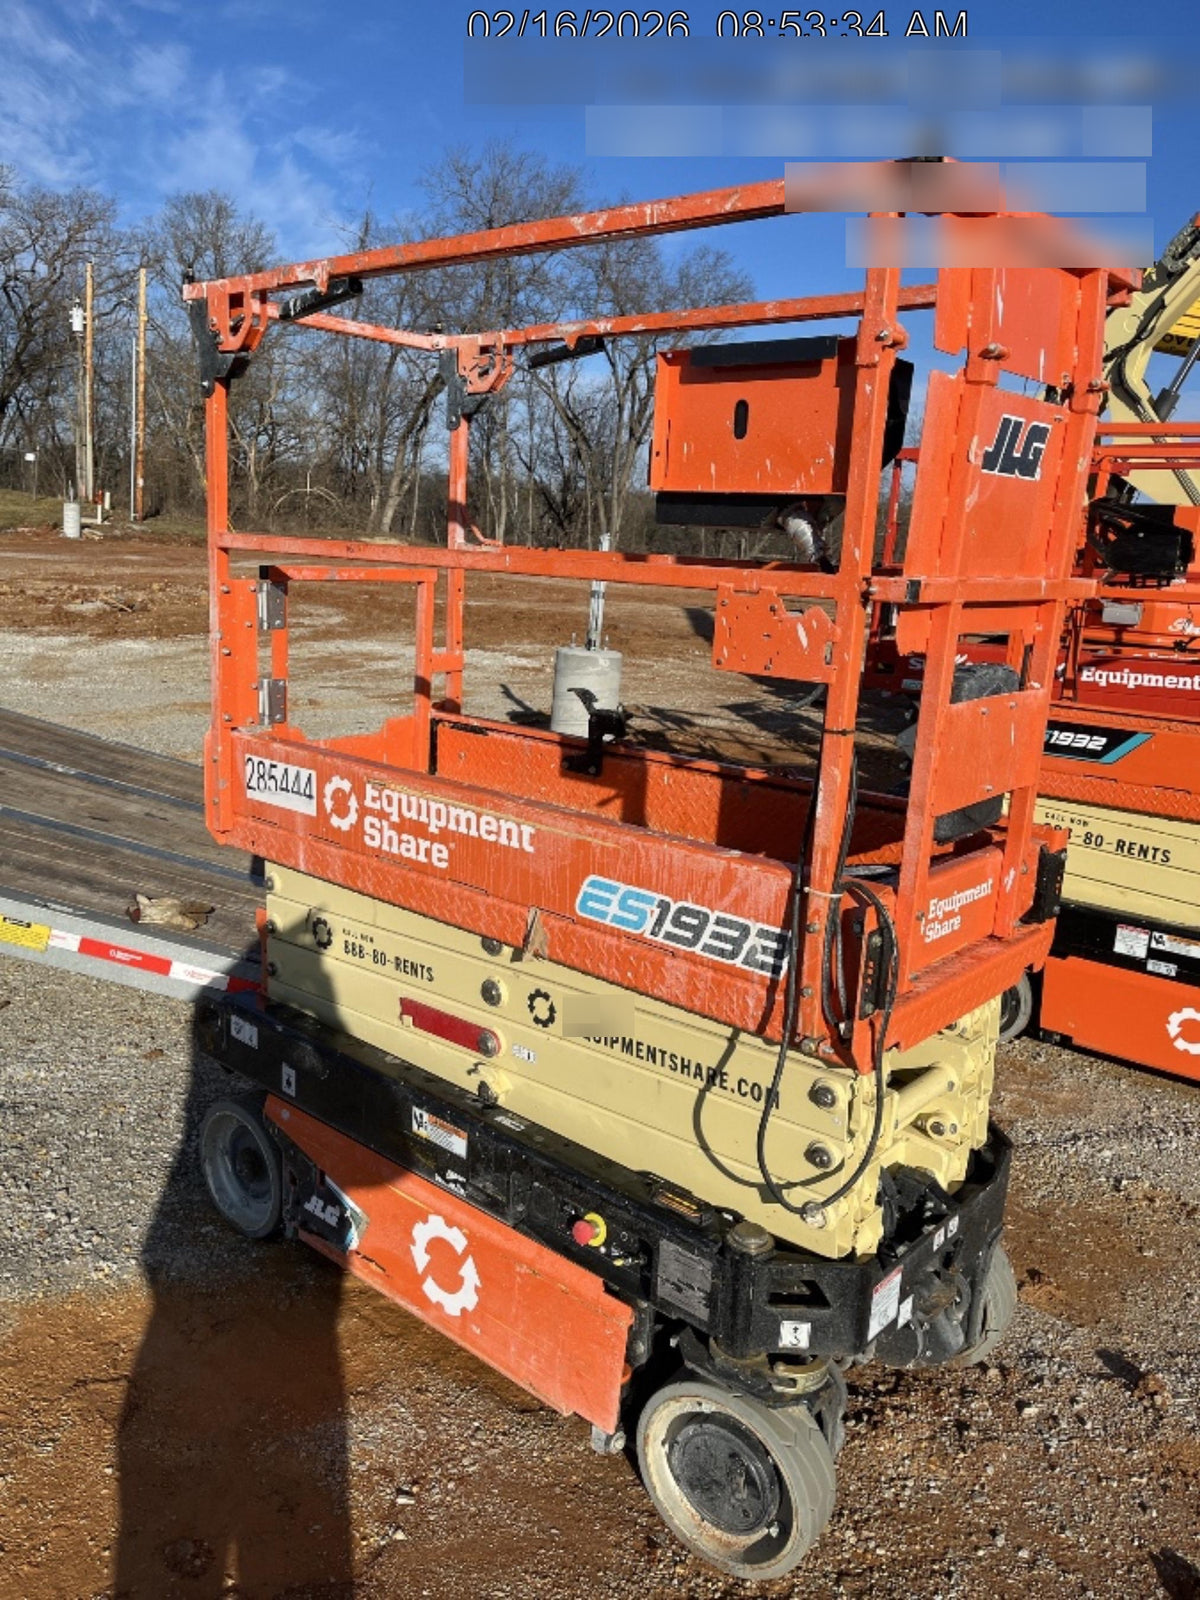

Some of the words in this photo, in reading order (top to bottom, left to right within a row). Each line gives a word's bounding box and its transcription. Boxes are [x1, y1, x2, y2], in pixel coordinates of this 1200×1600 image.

[981, 413, 1052, 481] JLG
[1081, 667, 1200, 691] Equipment
[246, 756, 315, 800] 285444
[364, 783, 536, 853] Equipment
[364, 815, 449, 869] Share
[928, 878, 994, 919] Equipment
[576, 874, 791, 981] ES1932
[924, 915, 961, 943] Share
